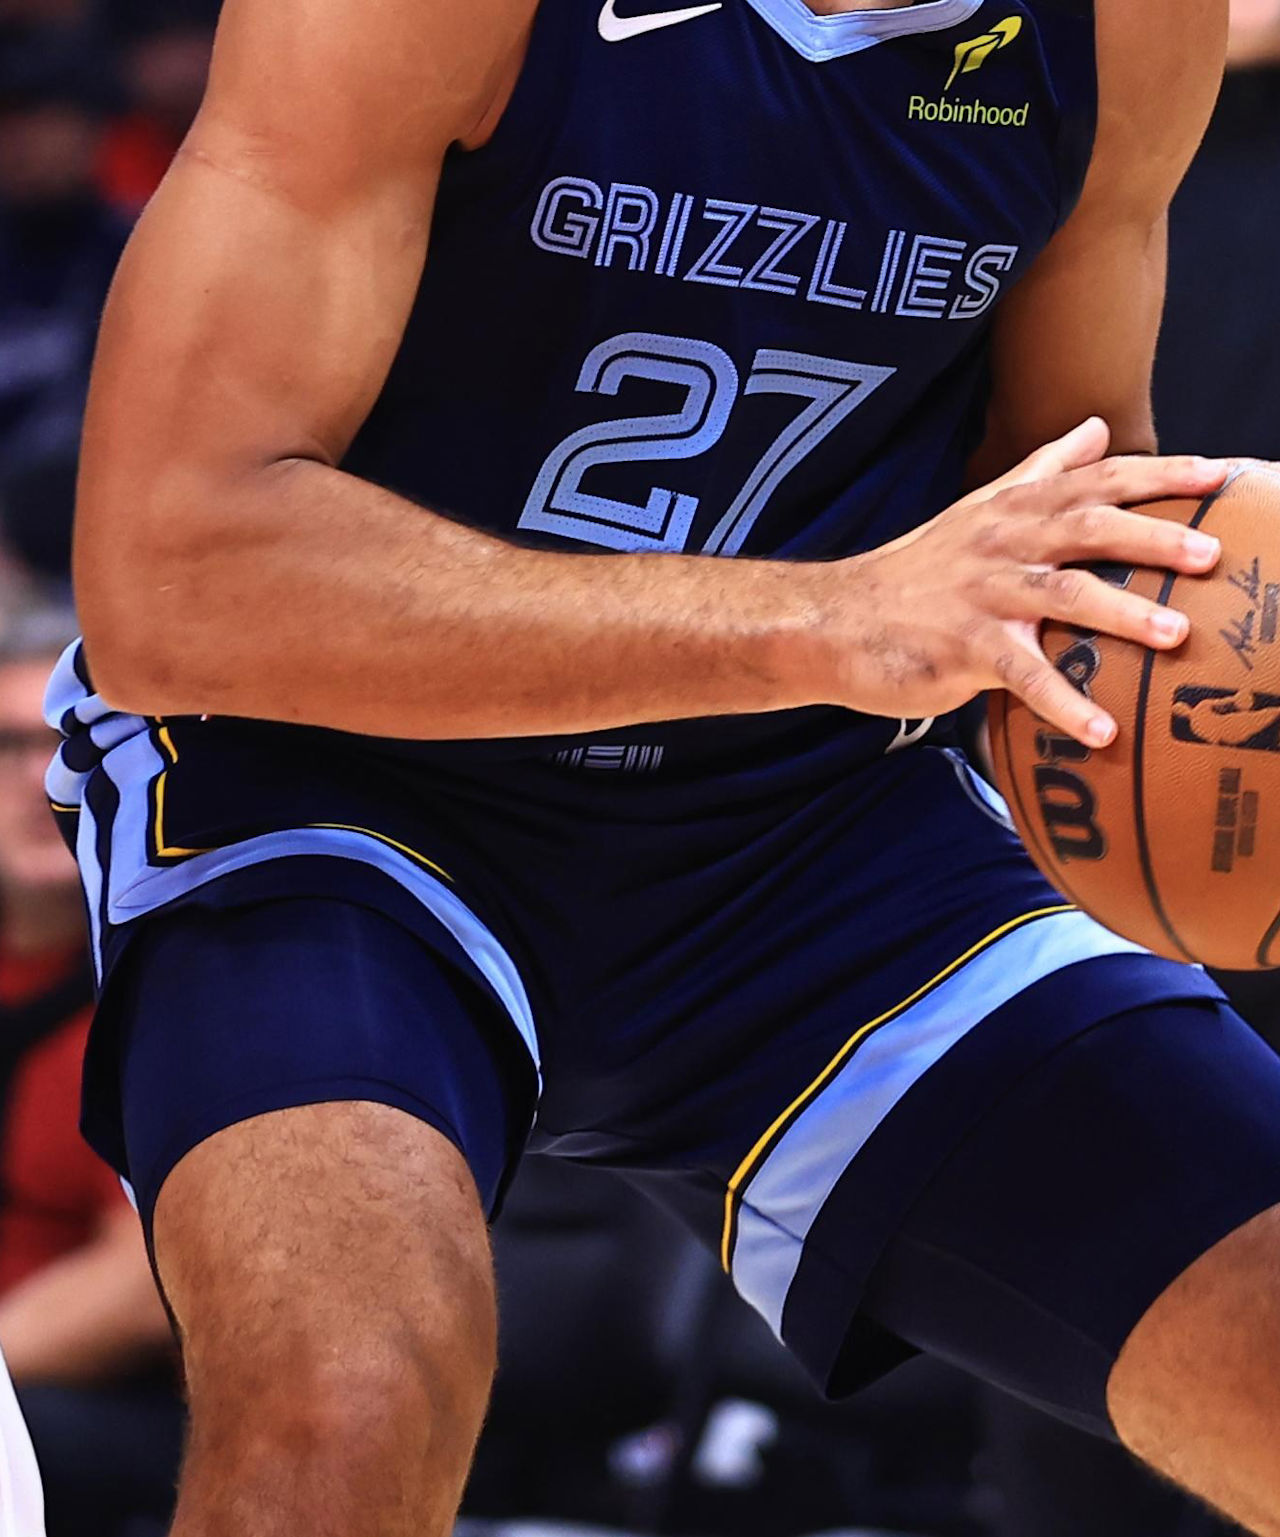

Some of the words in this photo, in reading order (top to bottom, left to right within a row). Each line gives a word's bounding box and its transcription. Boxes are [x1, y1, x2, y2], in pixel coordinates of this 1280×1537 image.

[907, 94, 1030, 127] Robinhood
[530, 175, 1019, 320] GRIZZLIES
[516, 331, 898, 556] 27
